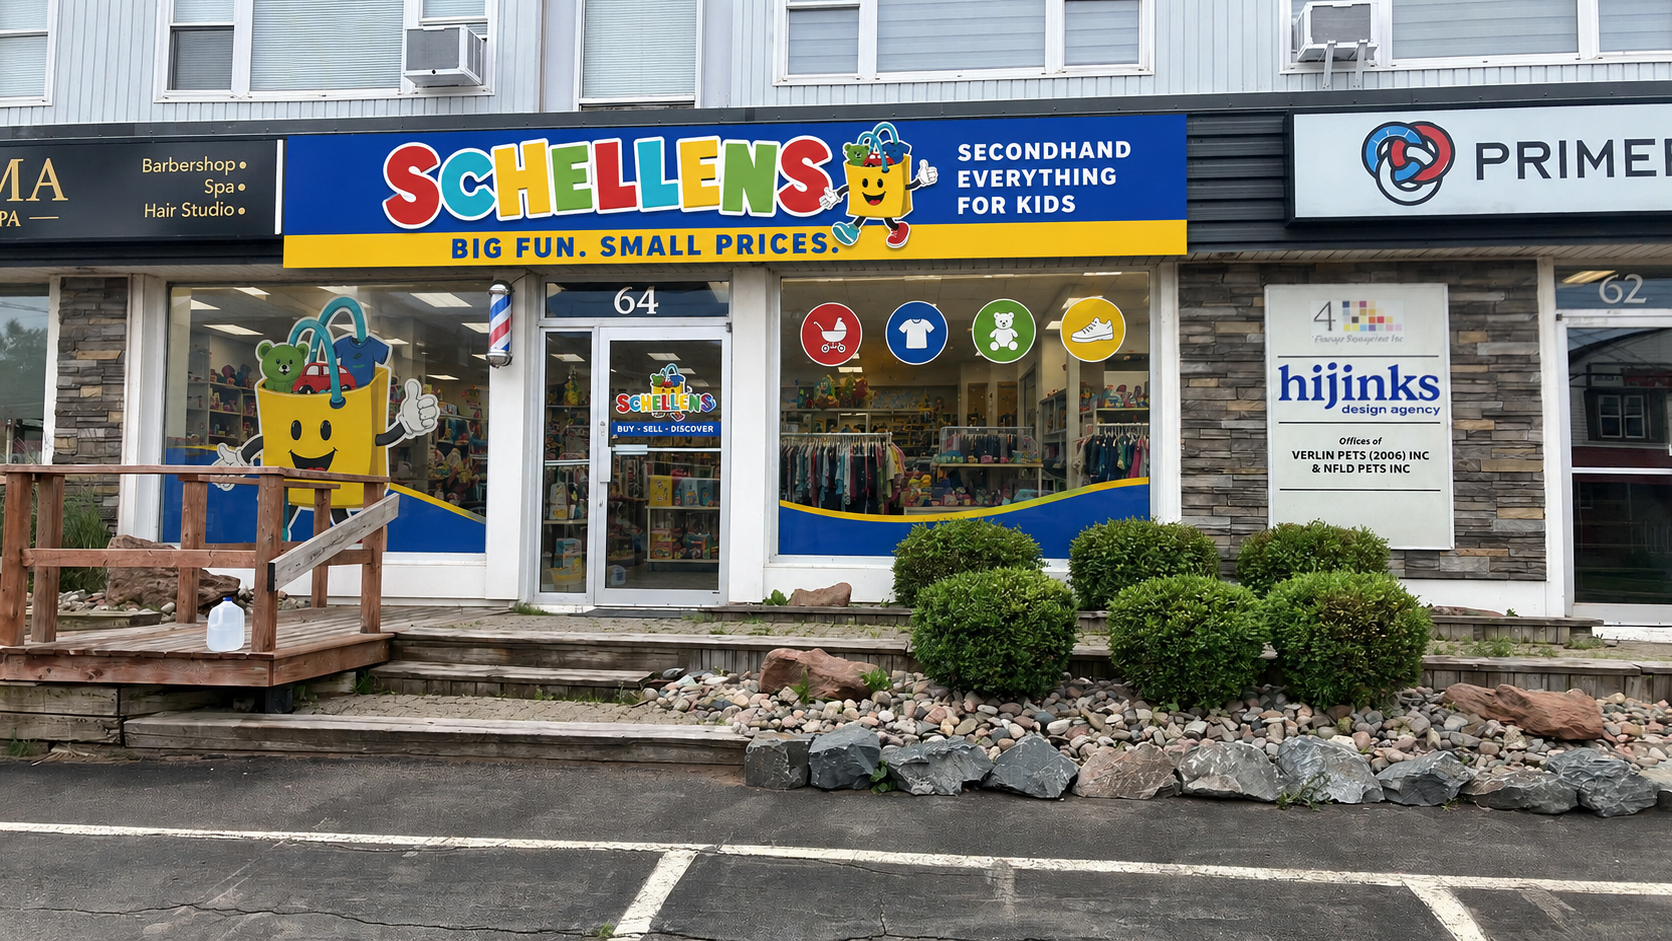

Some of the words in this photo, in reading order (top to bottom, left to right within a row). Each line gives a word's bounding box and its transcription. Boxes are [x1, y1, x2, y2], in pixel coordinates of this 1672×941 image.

[957, 140, 1131, 162] SECONDHAND
[1476, 138, 1672, 180] PRIME
[142, 156, 236, 175] Barbershop
[382, 135, 833, 229] SCHELLENS
[957, 167, 1117, 188] EVERYTHING
[204, 179, 235, 198] Spa
[144, 203, 177, 218] Hair
[181, 201, 235, 218] Studio
[957, 196, 1006, 215] FOR
[1016, 194, 1076, 214] KIDS
[451, 237, 502, 259] BIG
[516, 236, 587, 258] FUN.
[600, 235, 702, 257] SMALL
[716, 232, 839, 256] PRICES.
[1598, 273, 1648, 304] 62
[613, 285, 659, 315] 64
[1313, 300, 1336, 332] 4
[1278, 362, 1440, 410] hijinks
[616, 393, 717, 414] SCHELLENS
[1341, 404, 1387, 416] design
[1390, 405, 1441, 417] agency
[617, 425, 635, 433] BUY
[643, 425, 663, 433] SELL
[670, 425, 714, 433] DISCOVER
[1339, 437, 1371, 445] Offices
[1372, 437, 1383, 445] of
[1292, 450, 1335, 460] VERLIN
[1337, 450, 1366, 460] PETS
[1369, 450, 1406, 461] (2006)
[1409, 451, 1430, 460] INC
[1312, 464, 1321, 474] &
[1323, 464, 1355, 474] NFLD
[1358, 464, 1387, 474] PETS
[1389, 464, 1411, 474] INC
